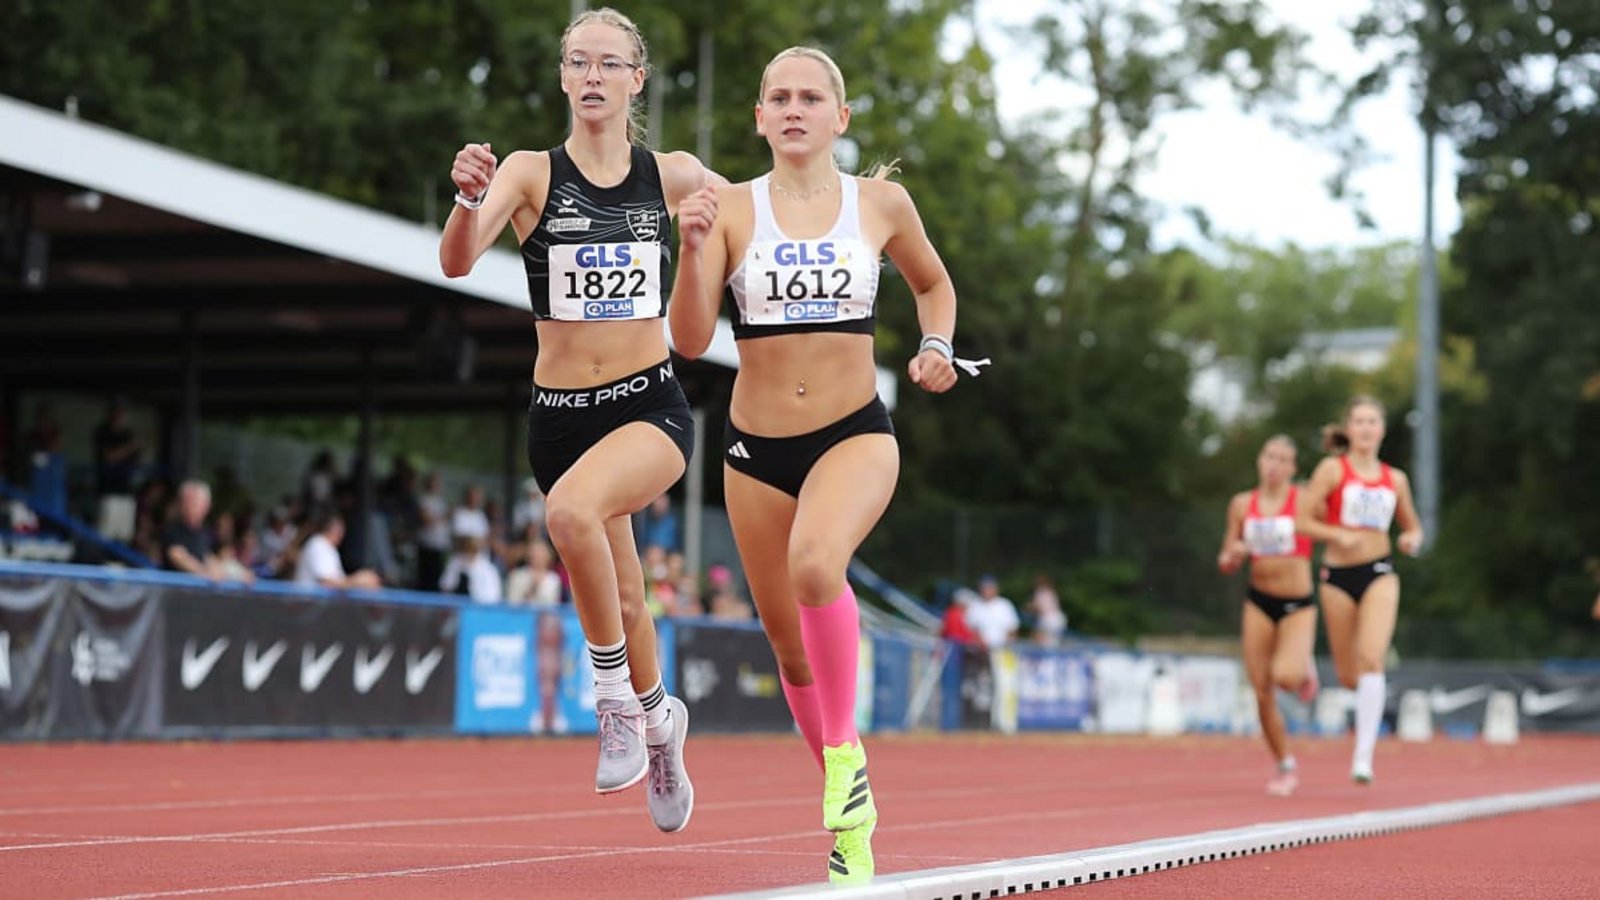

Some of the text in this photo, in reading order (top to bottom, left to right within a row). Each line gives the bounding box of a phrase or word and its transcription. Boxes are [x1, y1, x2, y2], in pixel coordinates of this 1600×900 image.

[564, 269, 646, 299] 1822
[765, 268, 852, 301] 1612
[605, 303, 632, 312] PLAN
[536, 391, 590, 408] NIKE
[595, 376, 649, 405] PRO
